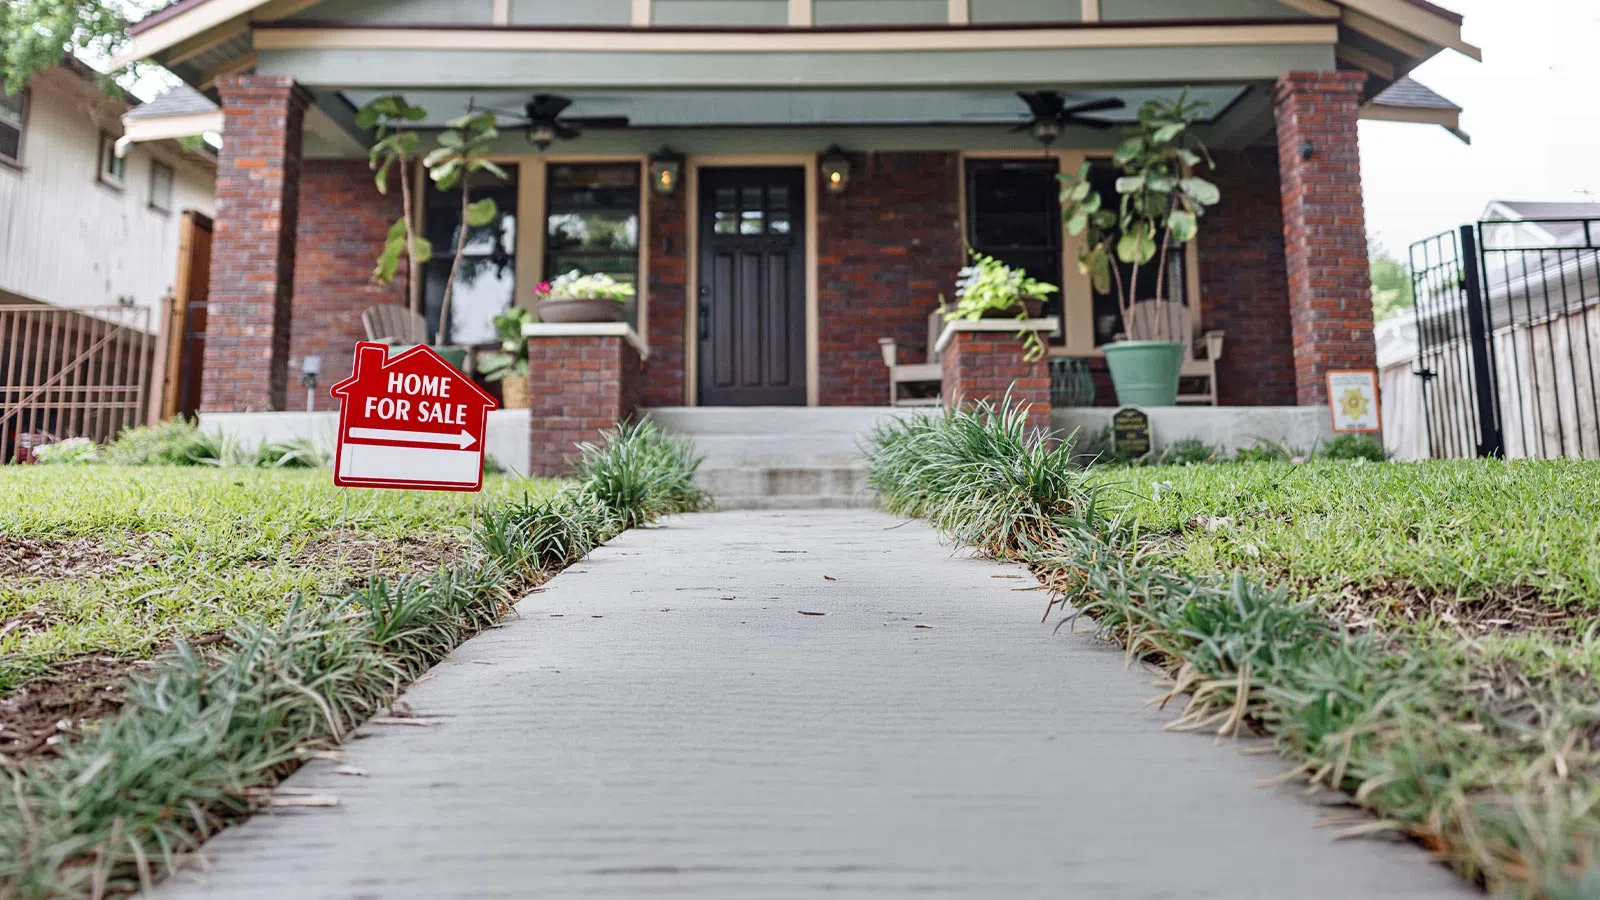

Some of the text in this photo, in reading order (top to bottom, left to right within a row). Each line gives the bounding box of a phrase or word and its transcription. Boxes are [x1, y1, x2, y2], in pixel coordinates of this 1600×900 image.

[387, 372, 452, 398] HOME
[364, 396, 468, 425] FOR SALE
